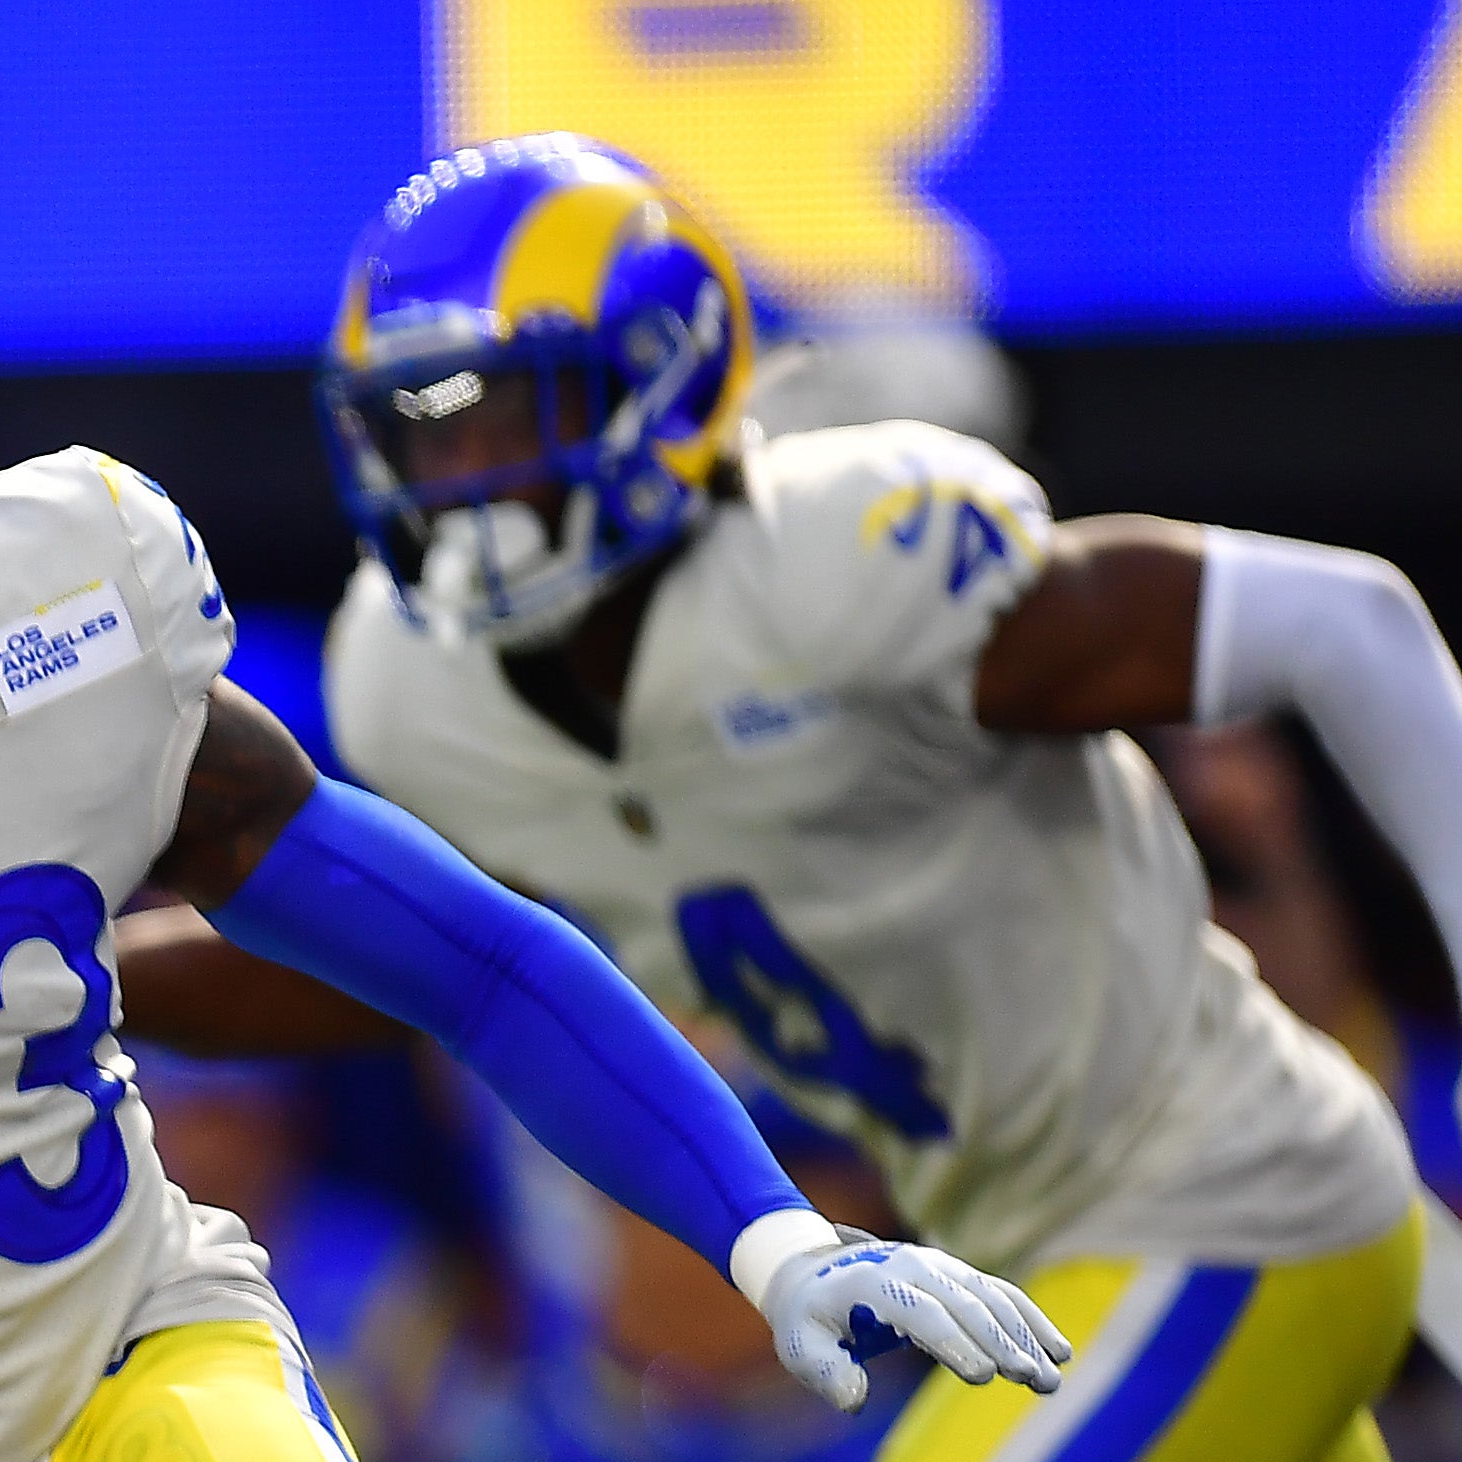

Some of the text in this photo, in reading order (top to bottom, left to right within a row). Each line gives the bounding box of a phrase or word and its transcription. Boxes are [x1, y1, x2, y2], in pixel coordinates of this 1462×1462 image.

[3, 610, 118, 675] ANGELES
[6, 650, 79, 693] RAMS
[676, 880, 952, 1140] 4
